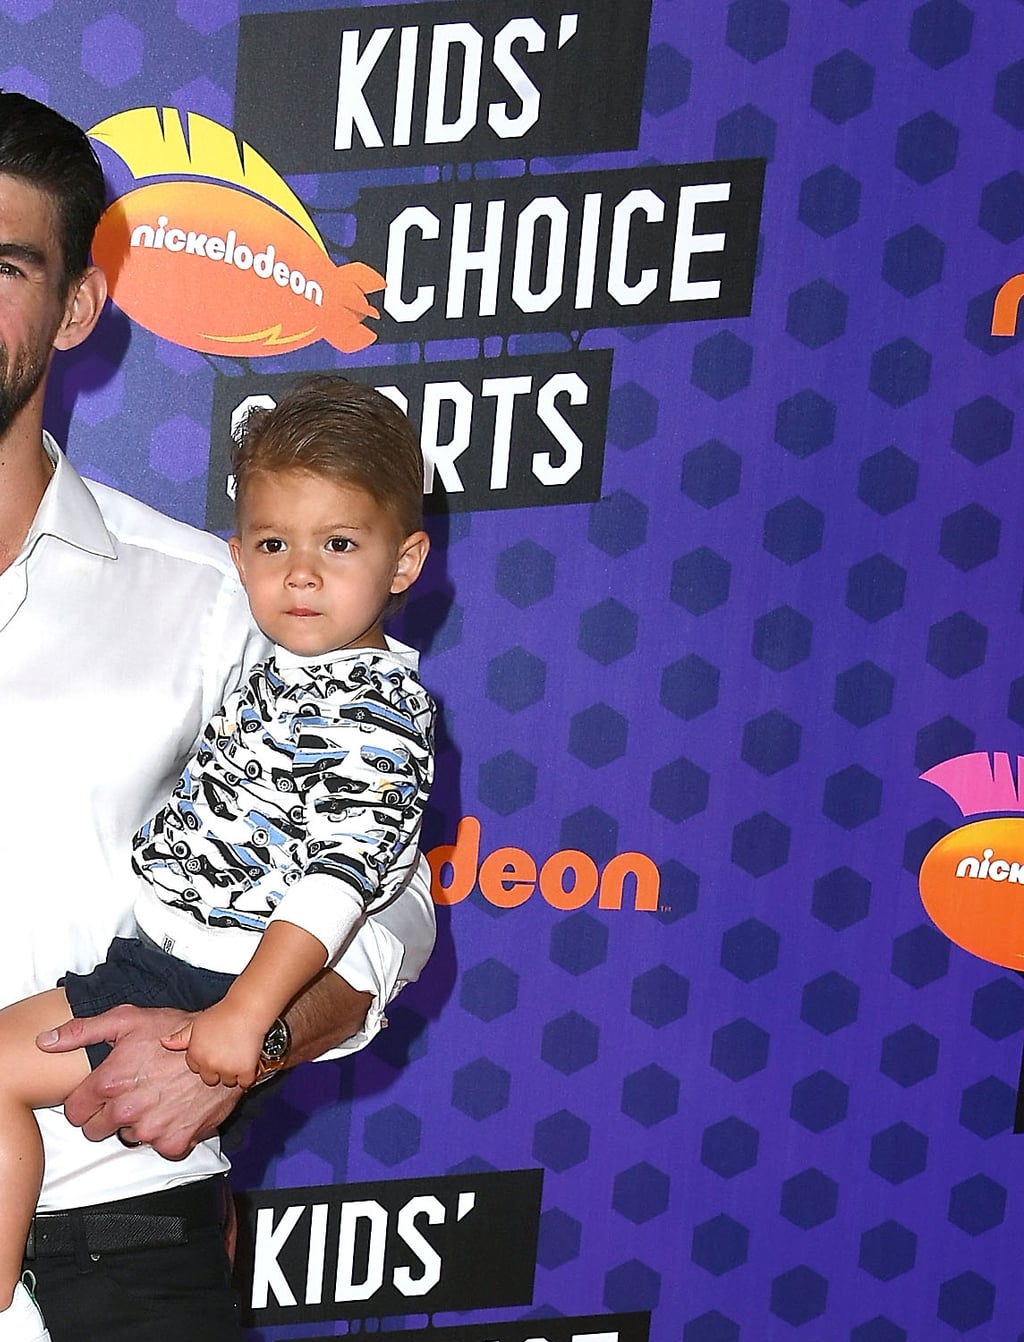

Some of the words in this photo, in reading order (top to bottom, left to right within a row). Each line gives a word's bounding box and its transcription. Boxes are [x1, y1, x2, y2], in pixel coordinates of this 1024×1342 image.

[334, 14, 578, 151] KIDS'
[130, 215, 324, 307] nickelodeon
[383, 182, 732, 324] CHOICE
[226, 372, 589, 501] RTS
[251, 1192, 476, 1309] KIDS'
